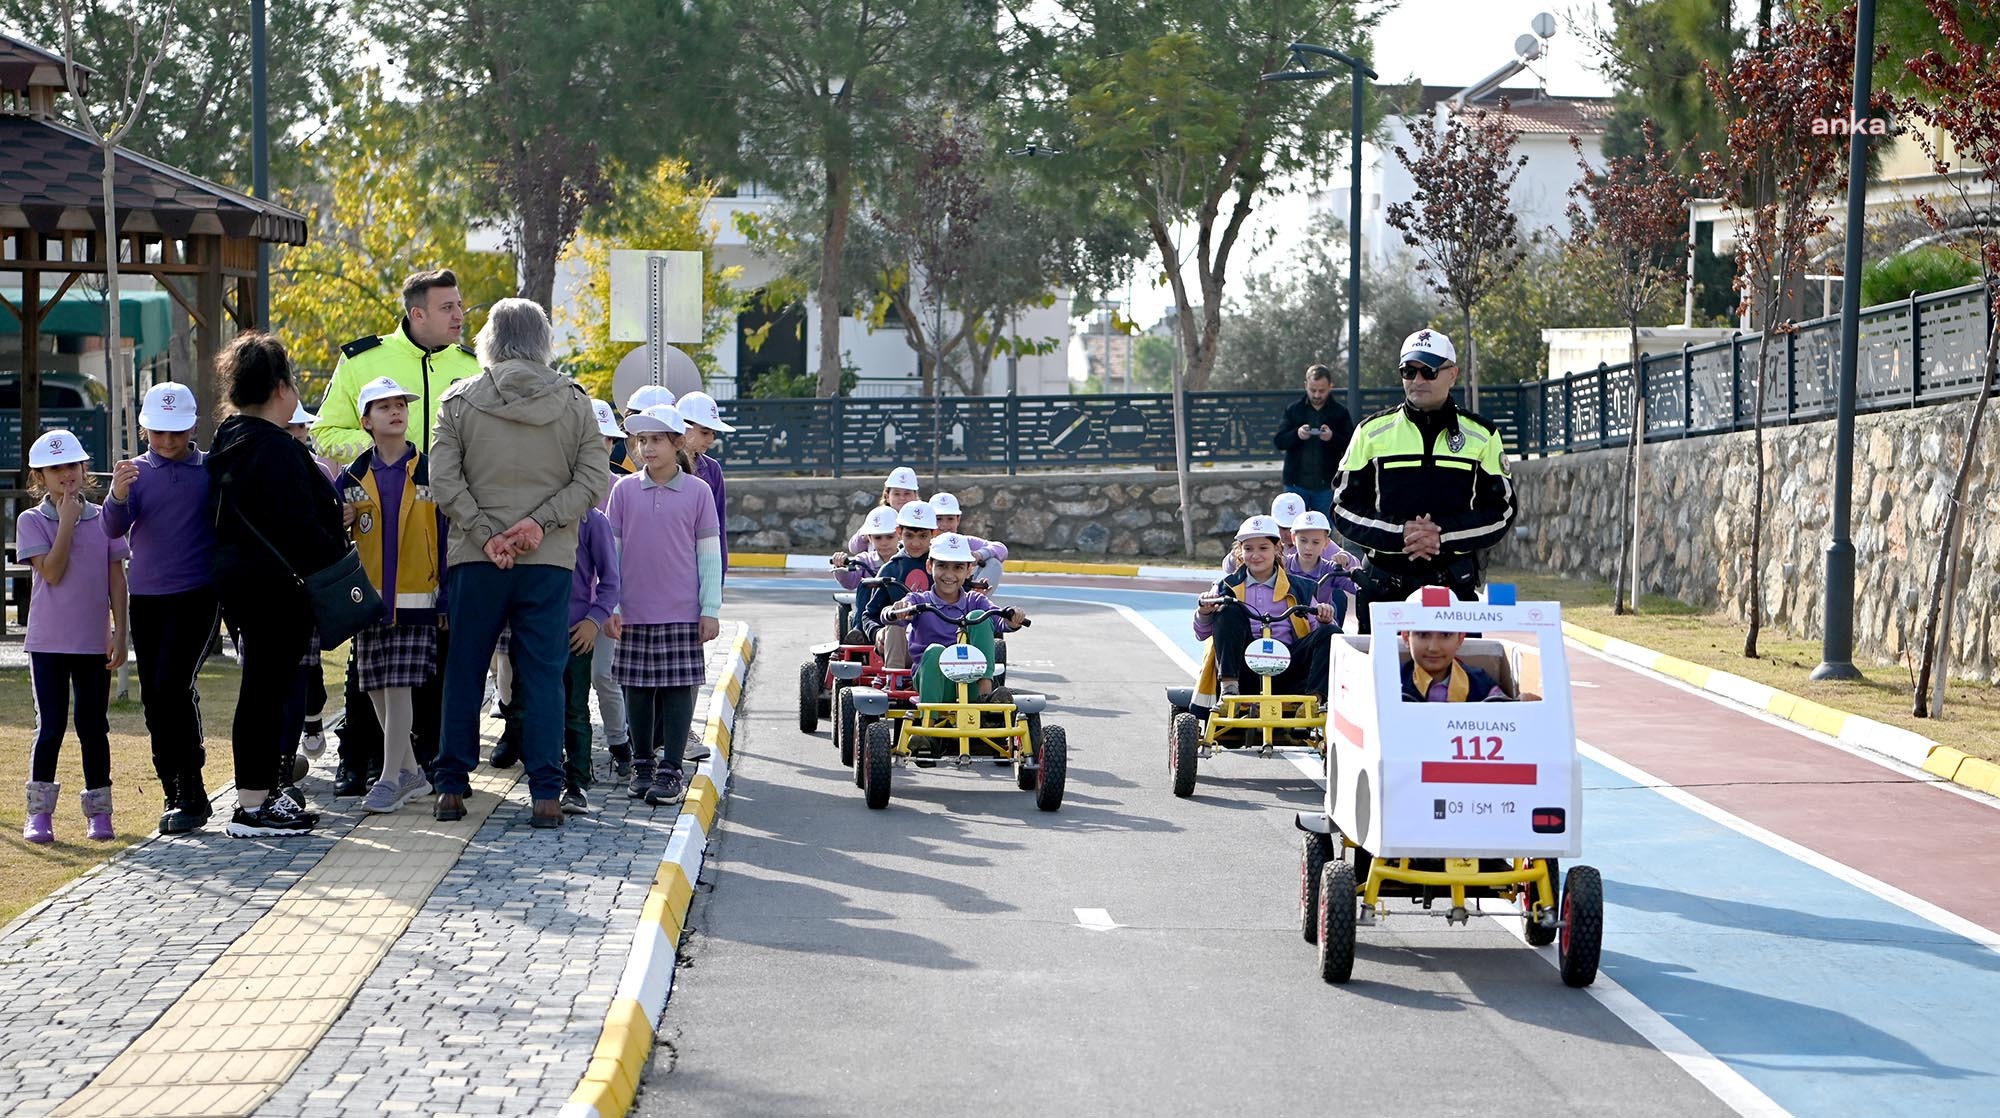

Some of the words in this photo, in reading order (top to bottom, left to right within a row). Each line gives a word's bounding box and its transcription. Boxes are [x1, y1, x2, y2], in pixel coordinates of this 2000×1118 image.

[1434, 611, 1503, 622] AMBULANS
[1446, 720, 1516, 732] AMBULANS
[1451, 736, 1505, 760] 112
[1448, 801, 1464, 814] 09
[1500, 801, 1516, 814] 112
